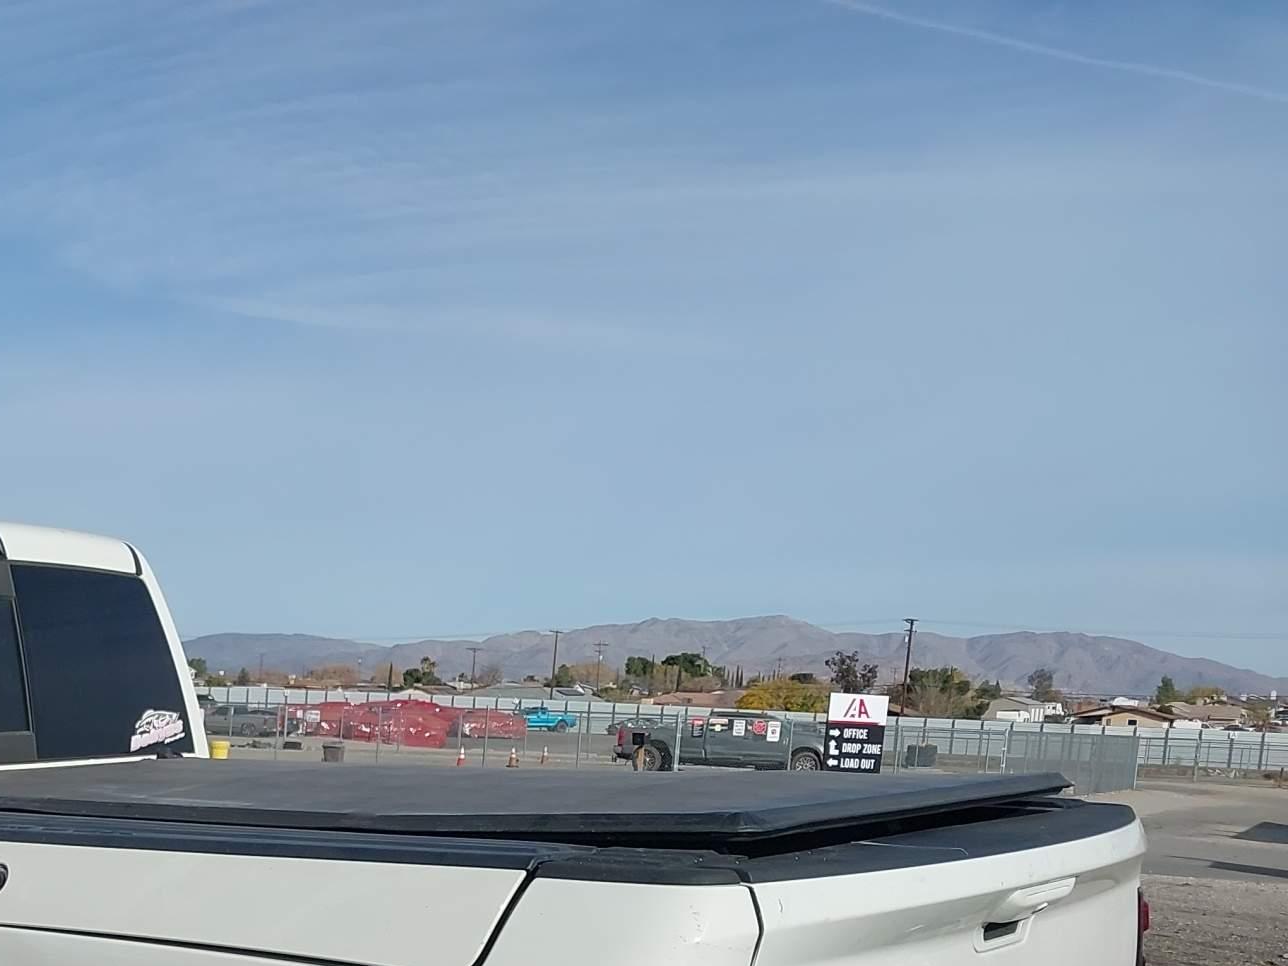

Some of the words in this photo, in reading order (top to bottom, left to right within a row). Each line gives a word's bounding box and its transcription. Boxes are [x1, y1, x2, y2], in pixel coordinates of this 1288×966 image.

[843, 728, 868, 739] OFFICE
[842, 743, 861, 754] DROP
[862, 744, 882, 755] ZONE
[840, 758, 859, 768] LOAD
[860, 759, 875, 769] OUT
